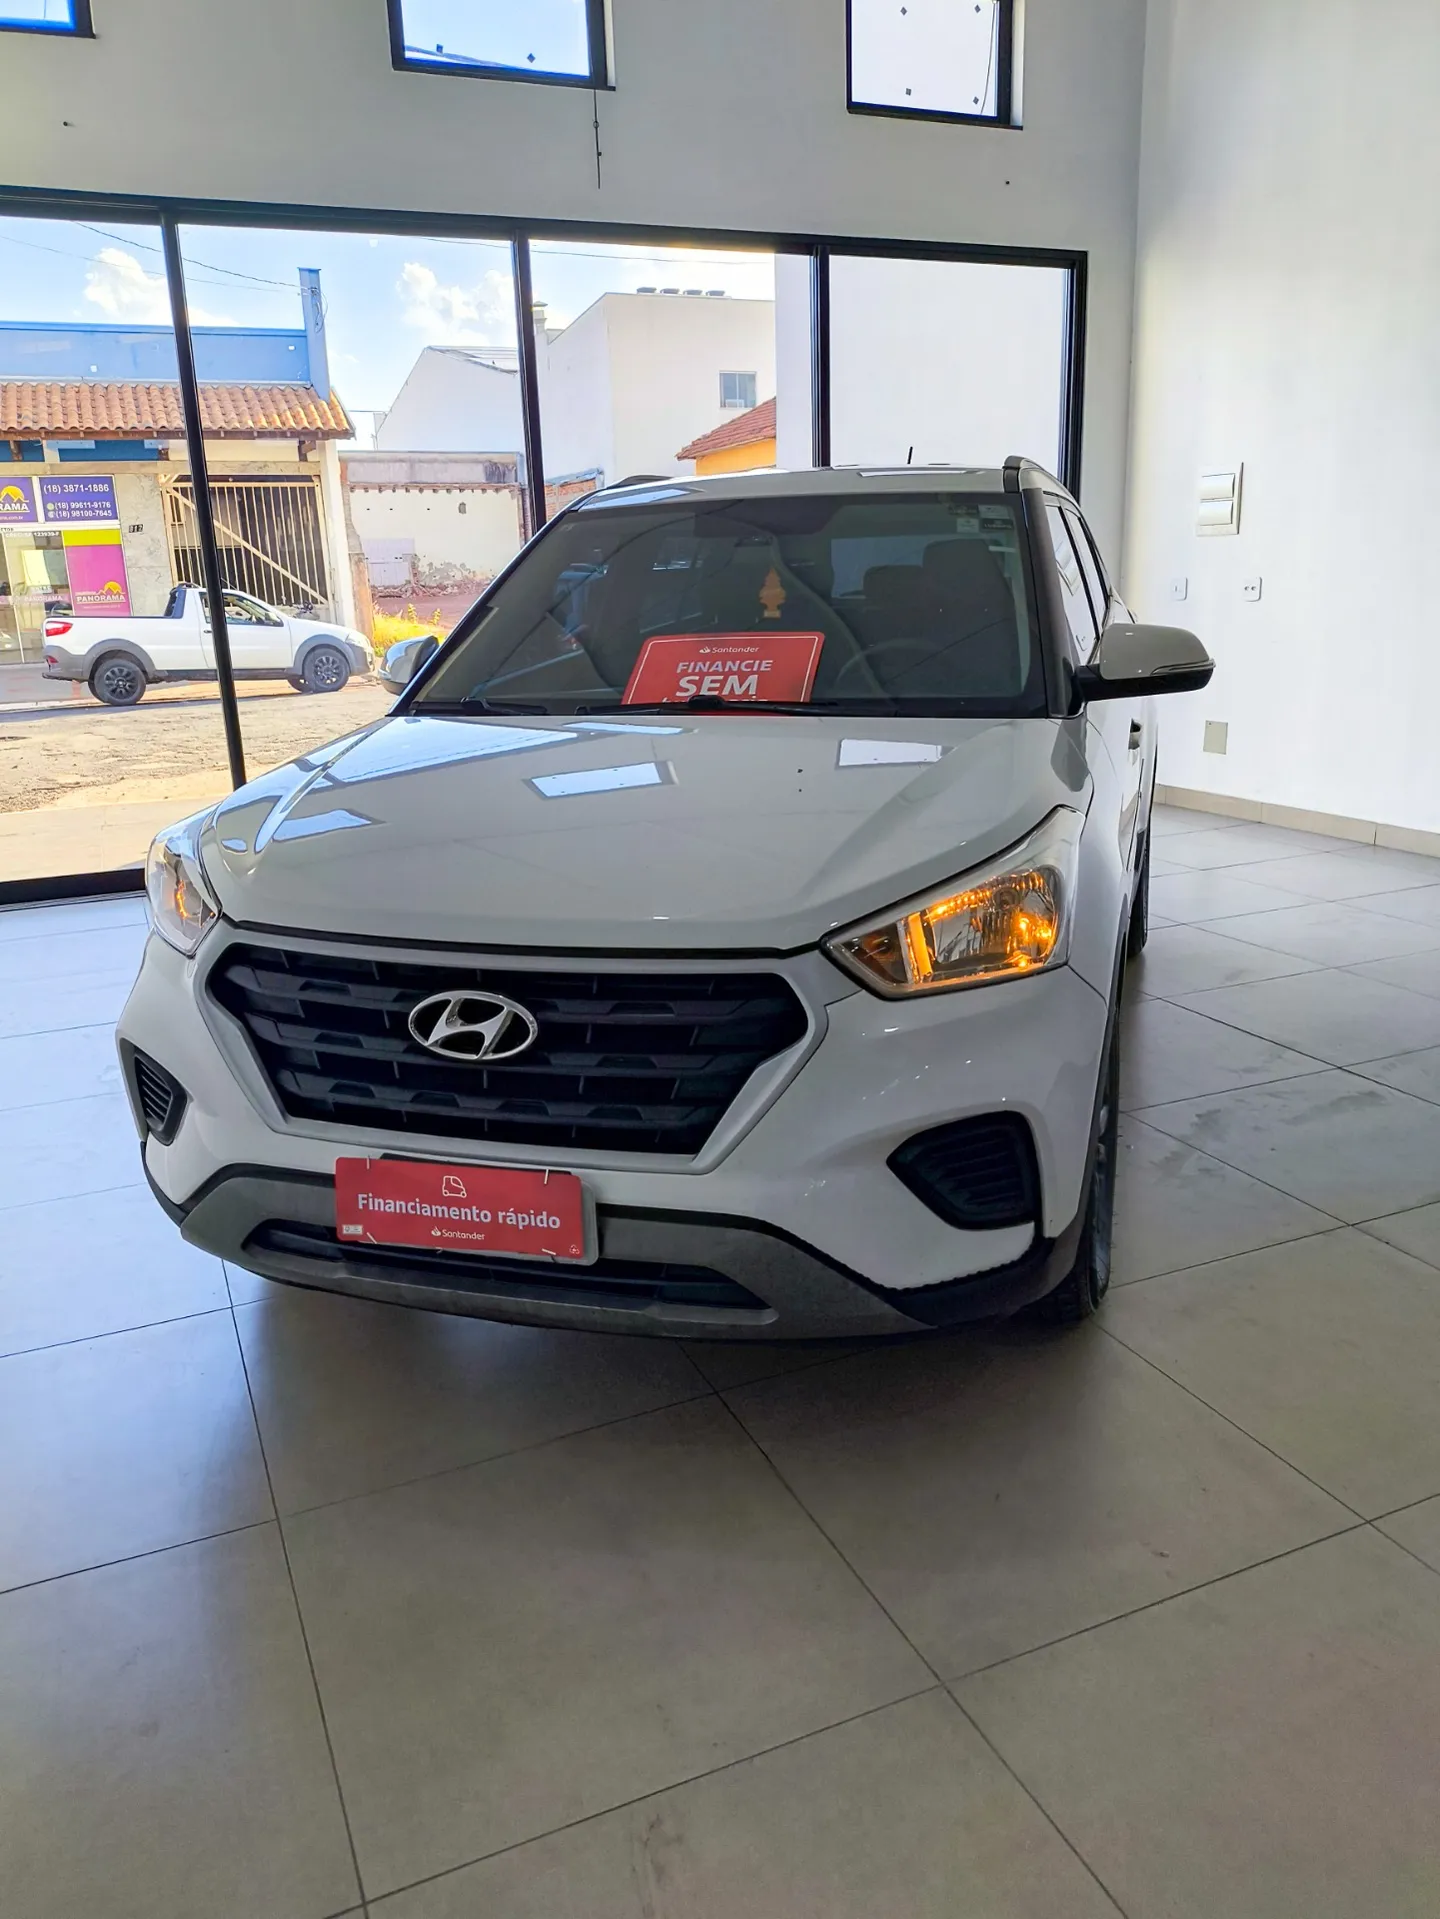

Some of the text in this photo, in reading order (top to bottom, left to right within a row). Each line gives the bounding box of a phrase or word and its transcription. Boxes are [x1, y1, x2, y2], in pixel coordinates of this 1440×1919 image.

[43, 484, 110, 494] (18) 3871-1886
[54, 502, 69, 510] (18)
[56, 510, 70, 518] (18)
[76, 594, 126, 602] PANORAMA
[712, 646, 759, 654] Santander
[676, 659, 773, 673] FINANCIE
[675, 674, 759, 697] SEM
[357, 1193, 561, 1230] Financiamento rápido
[442, 1228, 486, 1241] Santander
